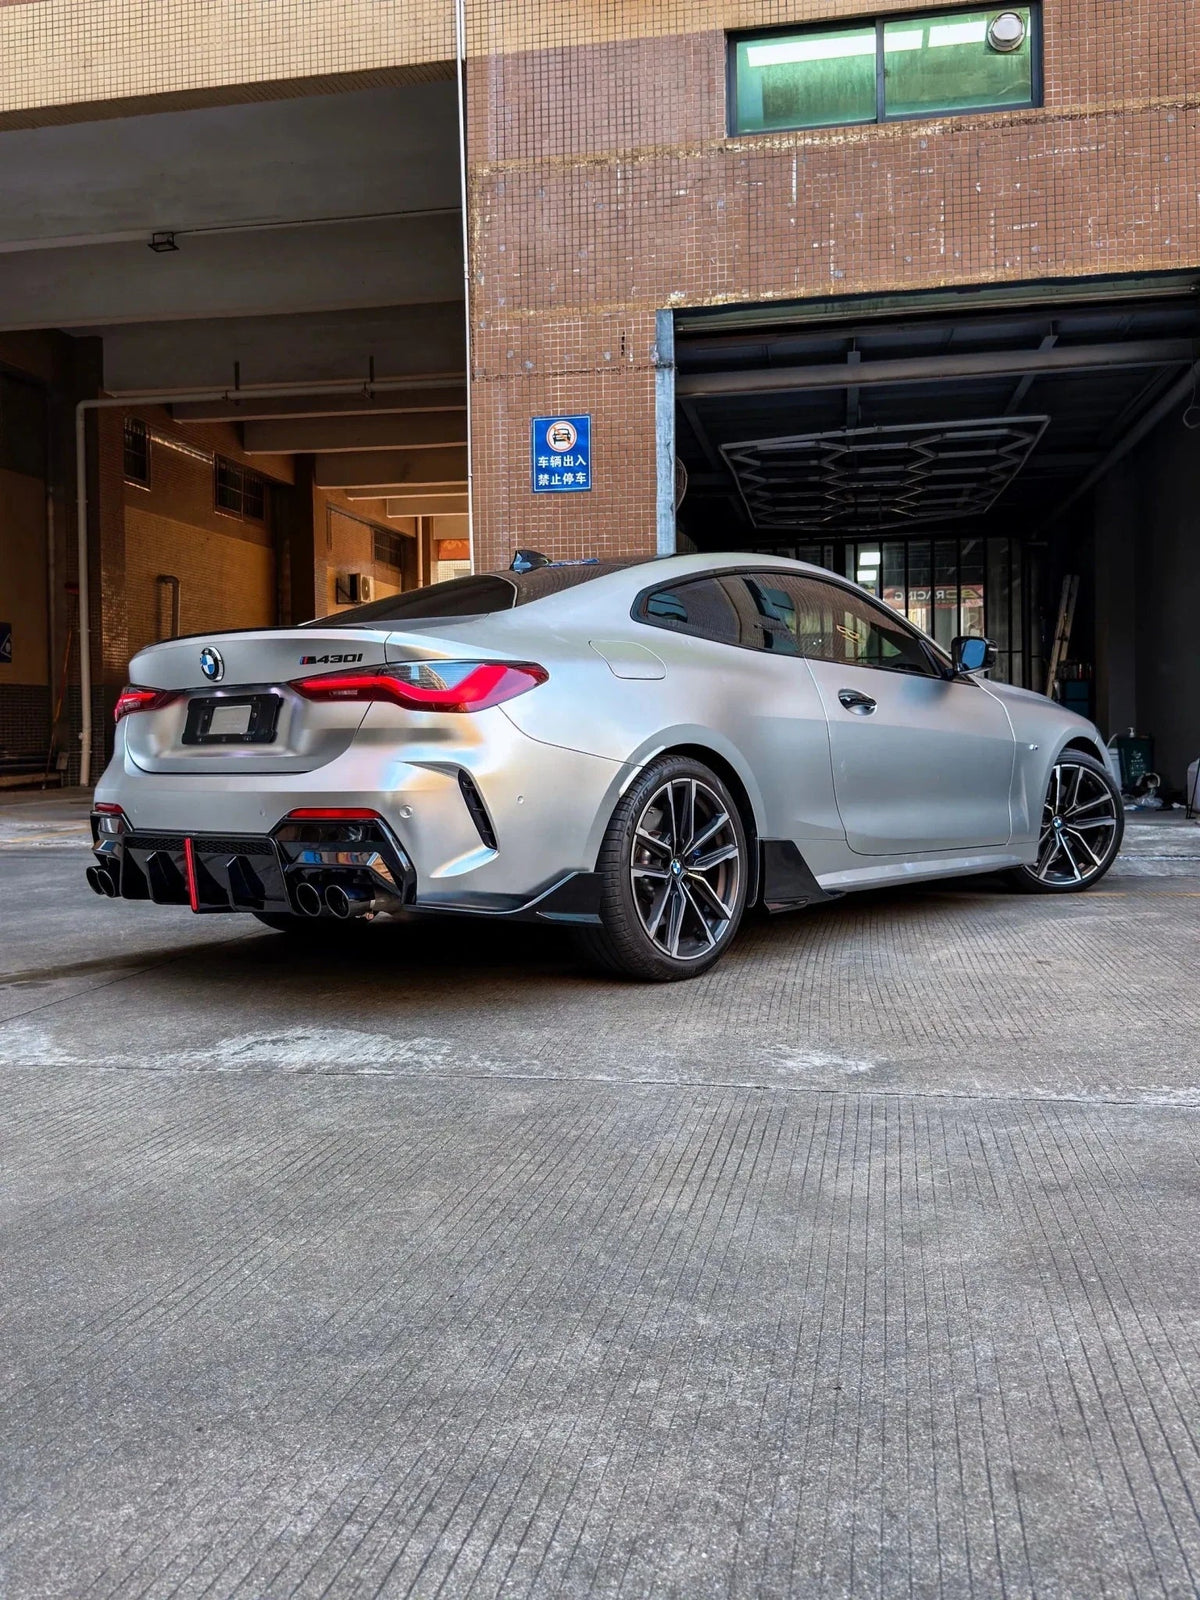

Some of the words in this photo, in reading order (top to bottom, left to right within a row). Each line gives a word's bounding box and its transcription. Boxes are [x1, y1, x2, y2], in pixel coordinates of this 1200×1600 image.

[537, 454, 587, 468] 车辆出入
[537, 471, 587, 486] 禁止停车
